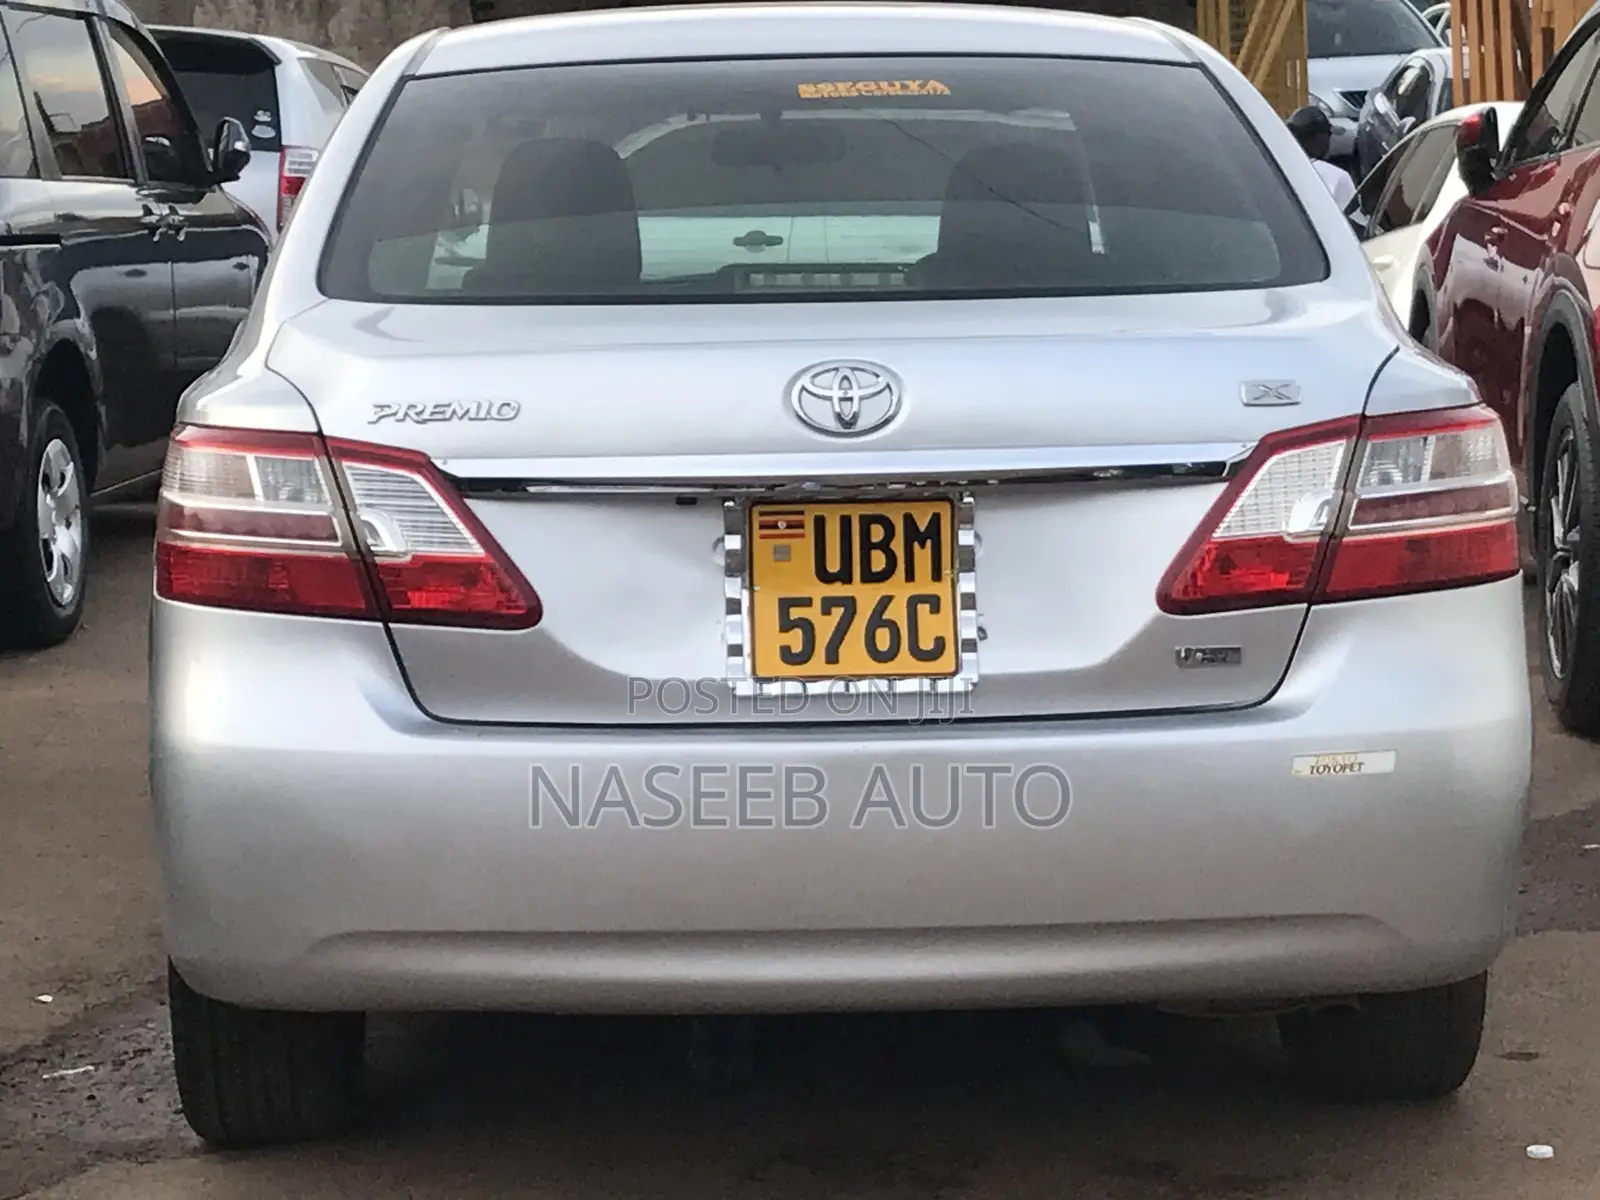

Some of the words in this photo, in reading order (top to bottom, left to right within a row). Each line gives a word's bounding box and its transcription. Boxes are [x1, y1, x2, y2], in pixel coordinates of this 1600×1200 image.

[367, 400, 521, 425] PREMIO
[813, 512, 942, 585] UBM
[777, 594, 946, 666] 576C
[1309, 762, 1365, 775] TOYOPET
